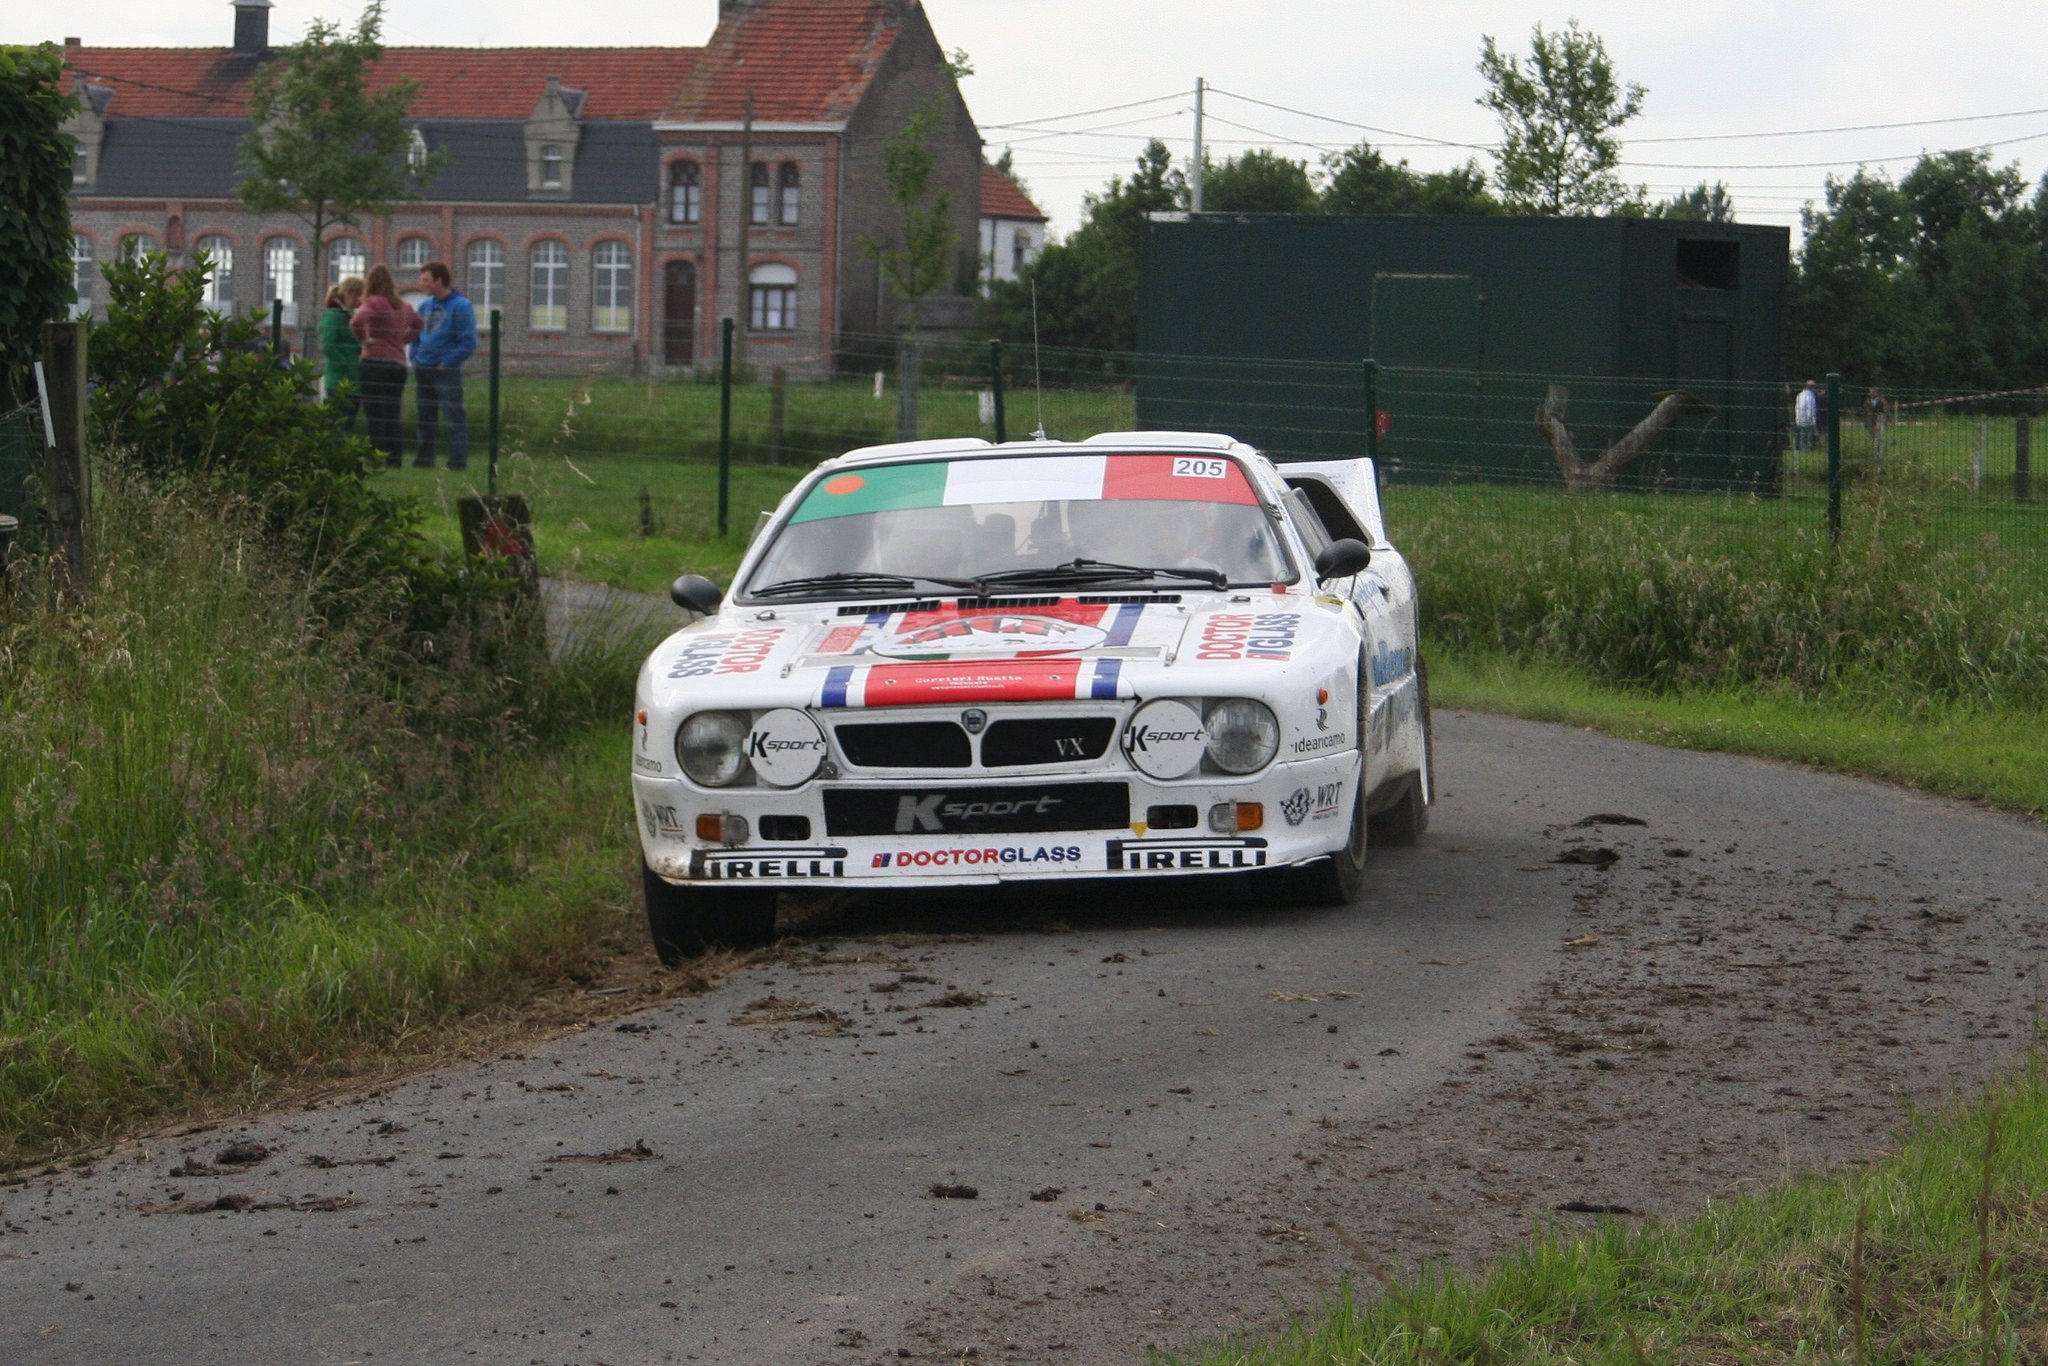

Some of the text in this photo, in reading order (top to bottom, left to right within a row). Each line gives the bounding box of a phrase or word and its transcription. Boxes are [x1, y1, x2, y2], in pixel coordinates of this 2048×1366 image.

[1176, 460, 1222, 476] 205
[714, 628, 785, 675] DOCTOR
[1196, 614, 1256, 660] DOCTOR
[1055, 737, 1085, 757] VX
[1317, 781, 1343, 808] WRT
[1106, 837, 1268, 870] PIRELLI
